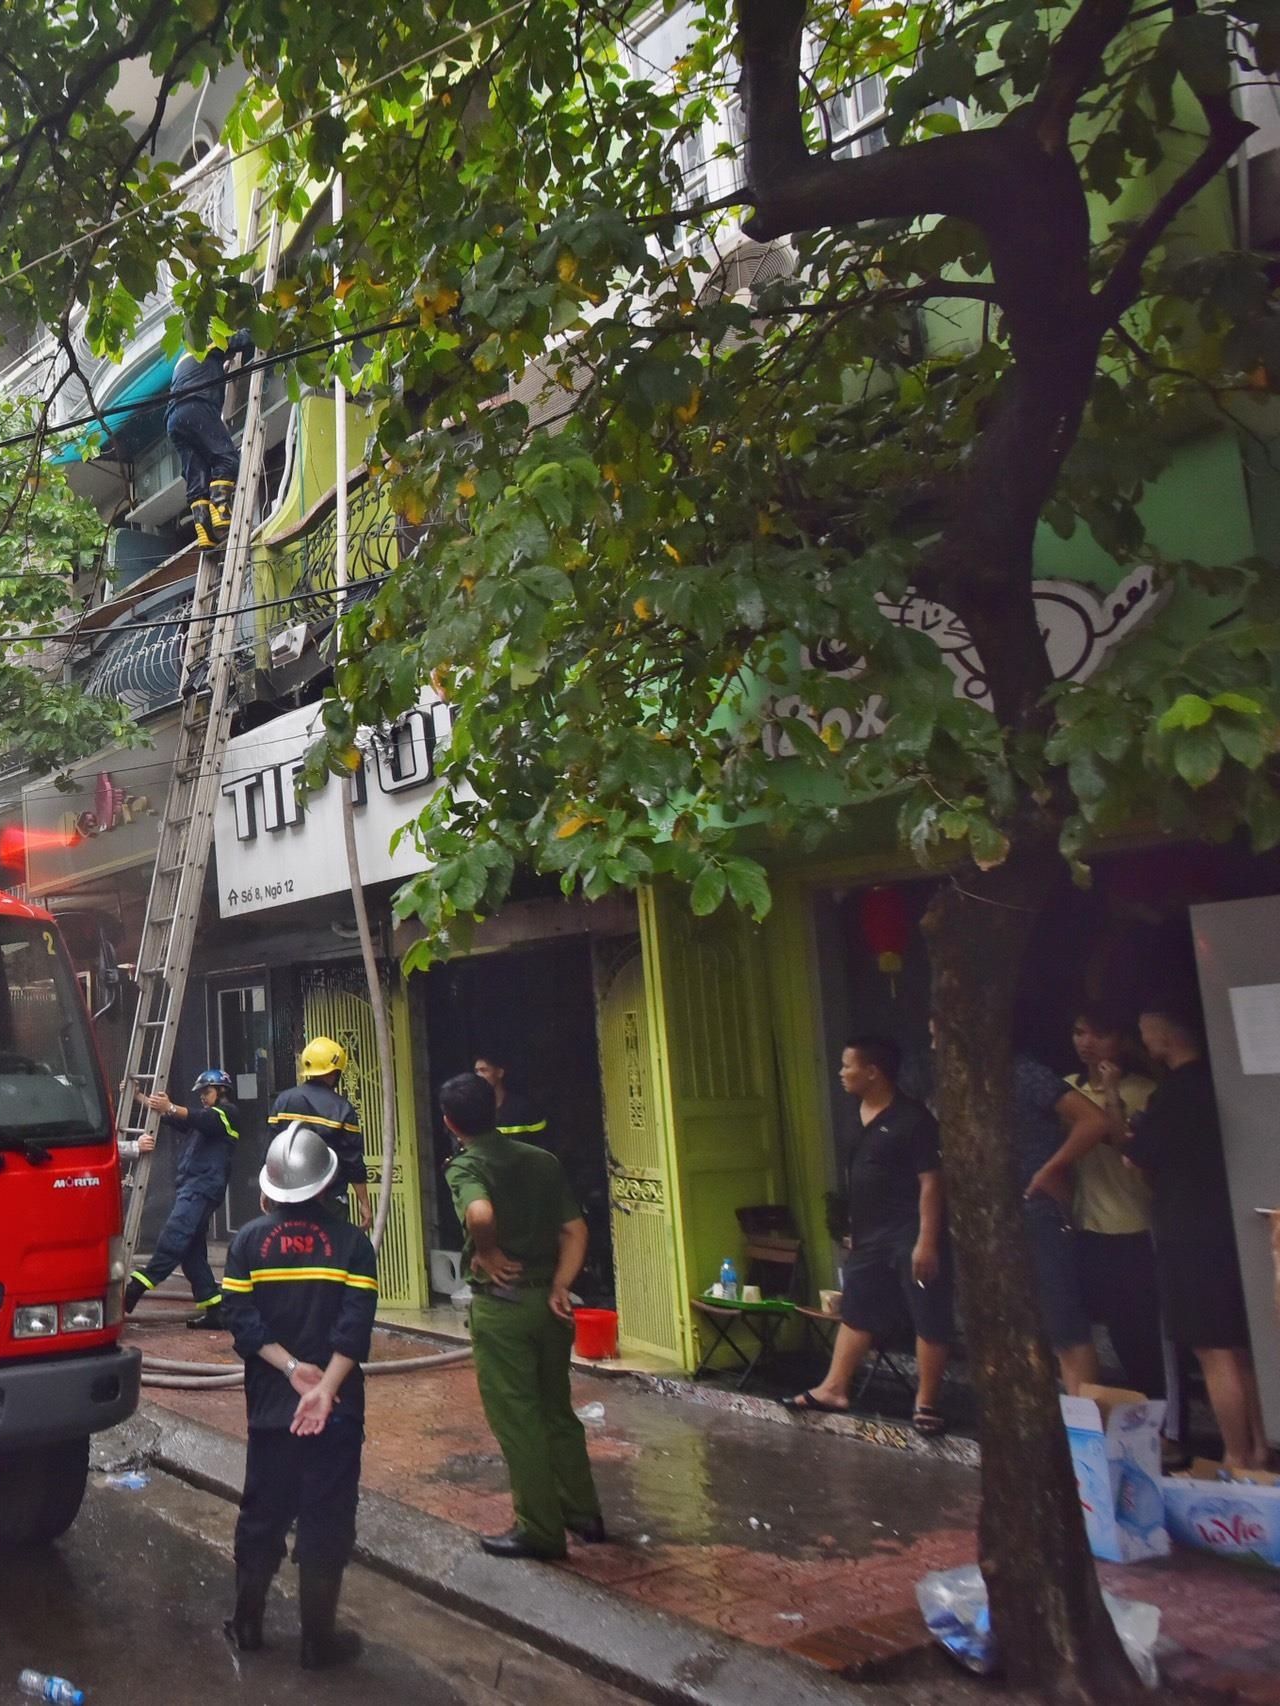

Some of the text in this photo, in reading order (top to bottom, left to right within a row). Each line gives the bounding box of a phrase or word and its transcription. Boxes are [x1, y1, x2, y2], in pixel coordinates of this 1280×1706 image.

[241, 879, 294, 903] Số 8, Ngõ 12
[42, 931, 57, 955] 2
[53, 1175, 100, 1189] MORITA
